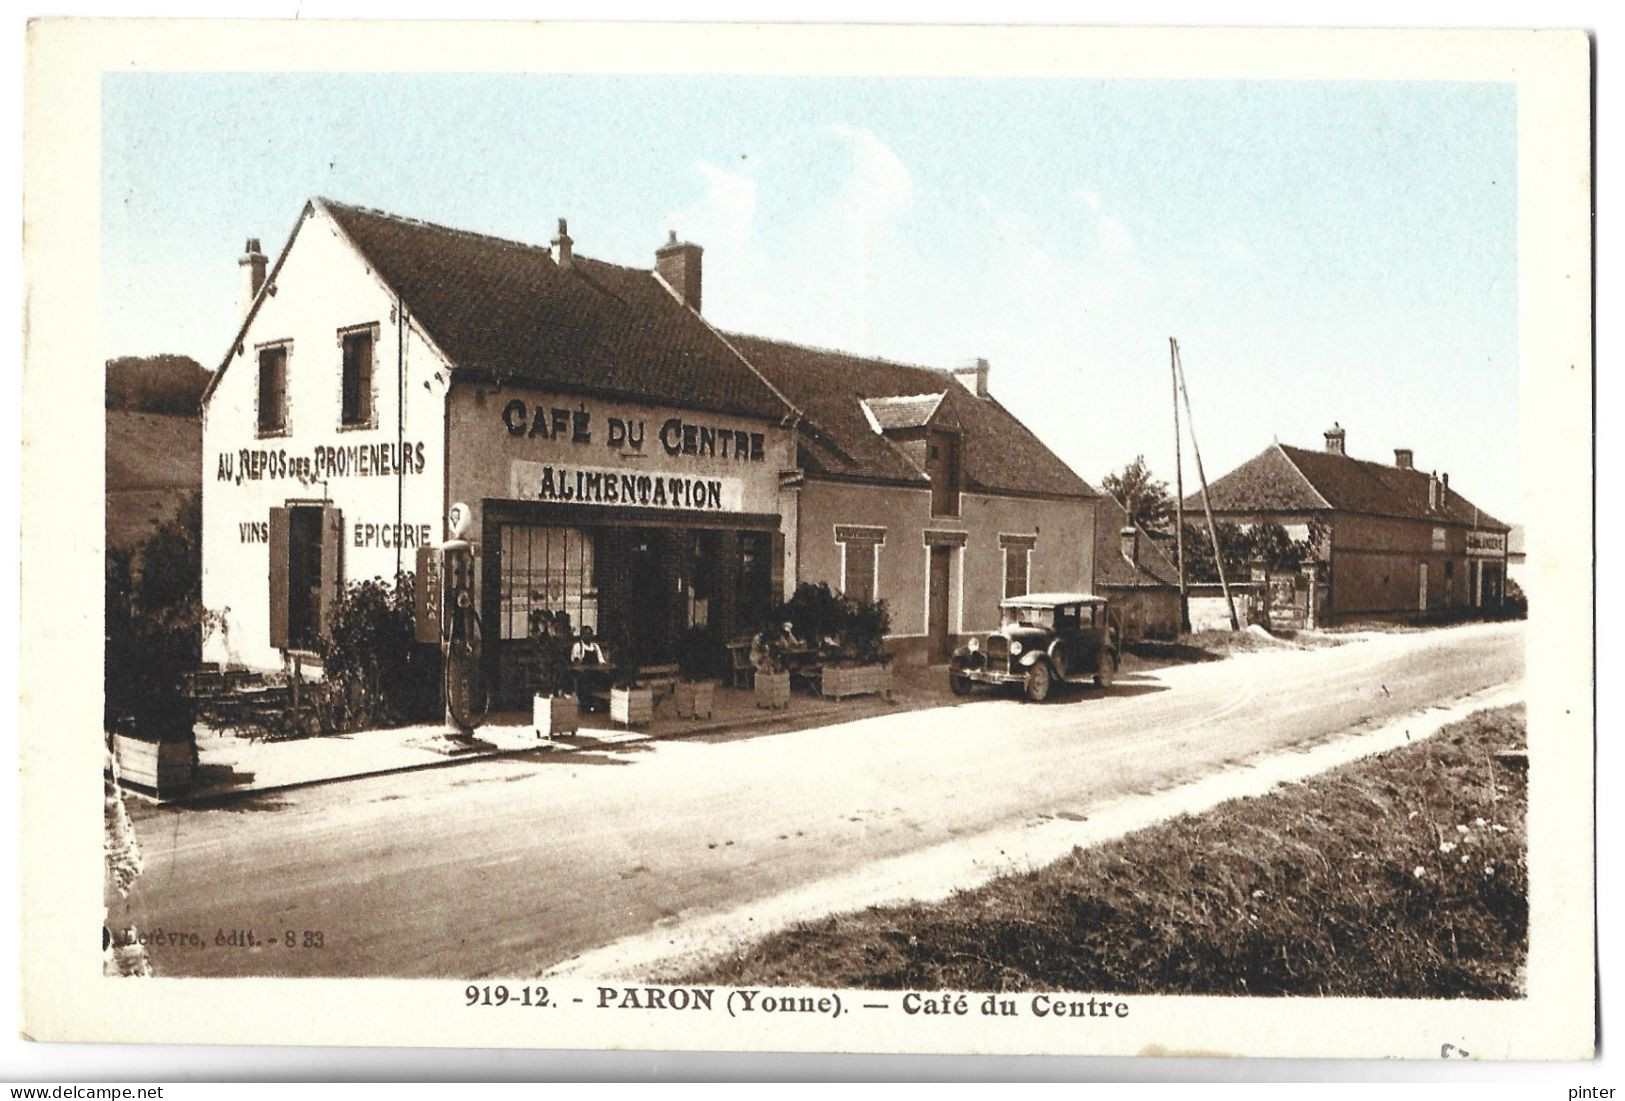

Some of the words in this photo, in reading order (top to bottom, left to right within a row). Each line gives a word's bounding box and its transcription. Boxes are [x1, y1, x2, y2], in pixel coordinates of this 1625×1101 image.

[607, 417, 645, 447] DU
[659, 418, 765, 460] CENTRE
[217, 452, 233, 482] AU
[235, 448, 287, 487] REPOS
[288, 456, 310, 478] DES
[311, 441, 426, 485] PROMENEURS
[538, 467, 722, 509] ALIMENTATION
[239, 521, 268, 543] VINS
[214, 929, 262, 946] édit.
[285, 930, 296, 948] 8
[303, 930, 325, 948] 33
[464, 985, 558, 1008] 919-12.
[596, 987, 715, 1010] PARON
[726, 990, 849, 1018] (Yonne).
[902, 993, 969, 1016] Café
[981, 995, 1019, 1016] du
[1031, 995, 1130, 1018] Centre
